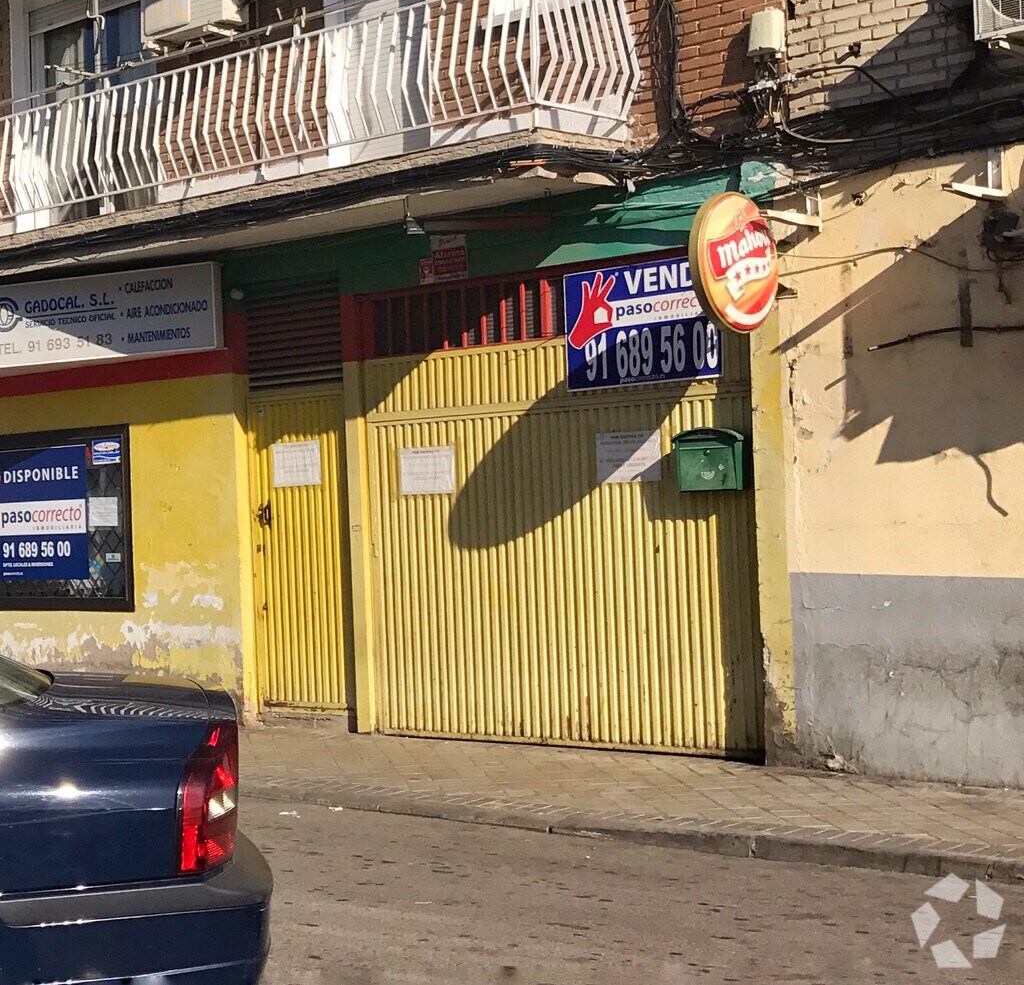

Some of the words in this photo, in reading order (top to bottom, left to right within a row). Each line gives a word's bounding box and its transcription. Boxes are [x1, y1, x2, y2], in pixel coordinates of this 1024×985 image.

[124, 278, 173, 294] CALEFACCION
[623, 262, 693, 294] VEND
[90, 293, 114, 307] S.L.
[126, 307, 142, 319] AIRE
[144, 299, 208, 317] ACONDICIONADO
[615, 296, 698, 320] pasocorrec
[25, 317, 56, 328] SERVICIO
[58, 315, 87, 326] TECNICO
[89, 313, 116, 322] OFICIAL
[654, 311, 698, 321] INMOBILIA
[28, 340, 41, 352] 91
[47, 338, 71, 351] 693
[77, 336, 90, 348] 51
[96, 333, 113, 346] 83
[127, 327, 191, 344] MANTENIMIENTOS
[584, 332, 607, 381] 91
[615, 327, 653, 378] 689
[660, 323, 686, 373] 56
[692, 321, 718, 369] 00
[3, 466, 79, 484] DISPONIBLE
[1, 506, 81, 528] pasocorrecto
[2, 542, 15, 558] 91
[18, 541, 38, 558] 689
[41, 541, 54, 557] 56
[57, 540, 71, 557] 00
